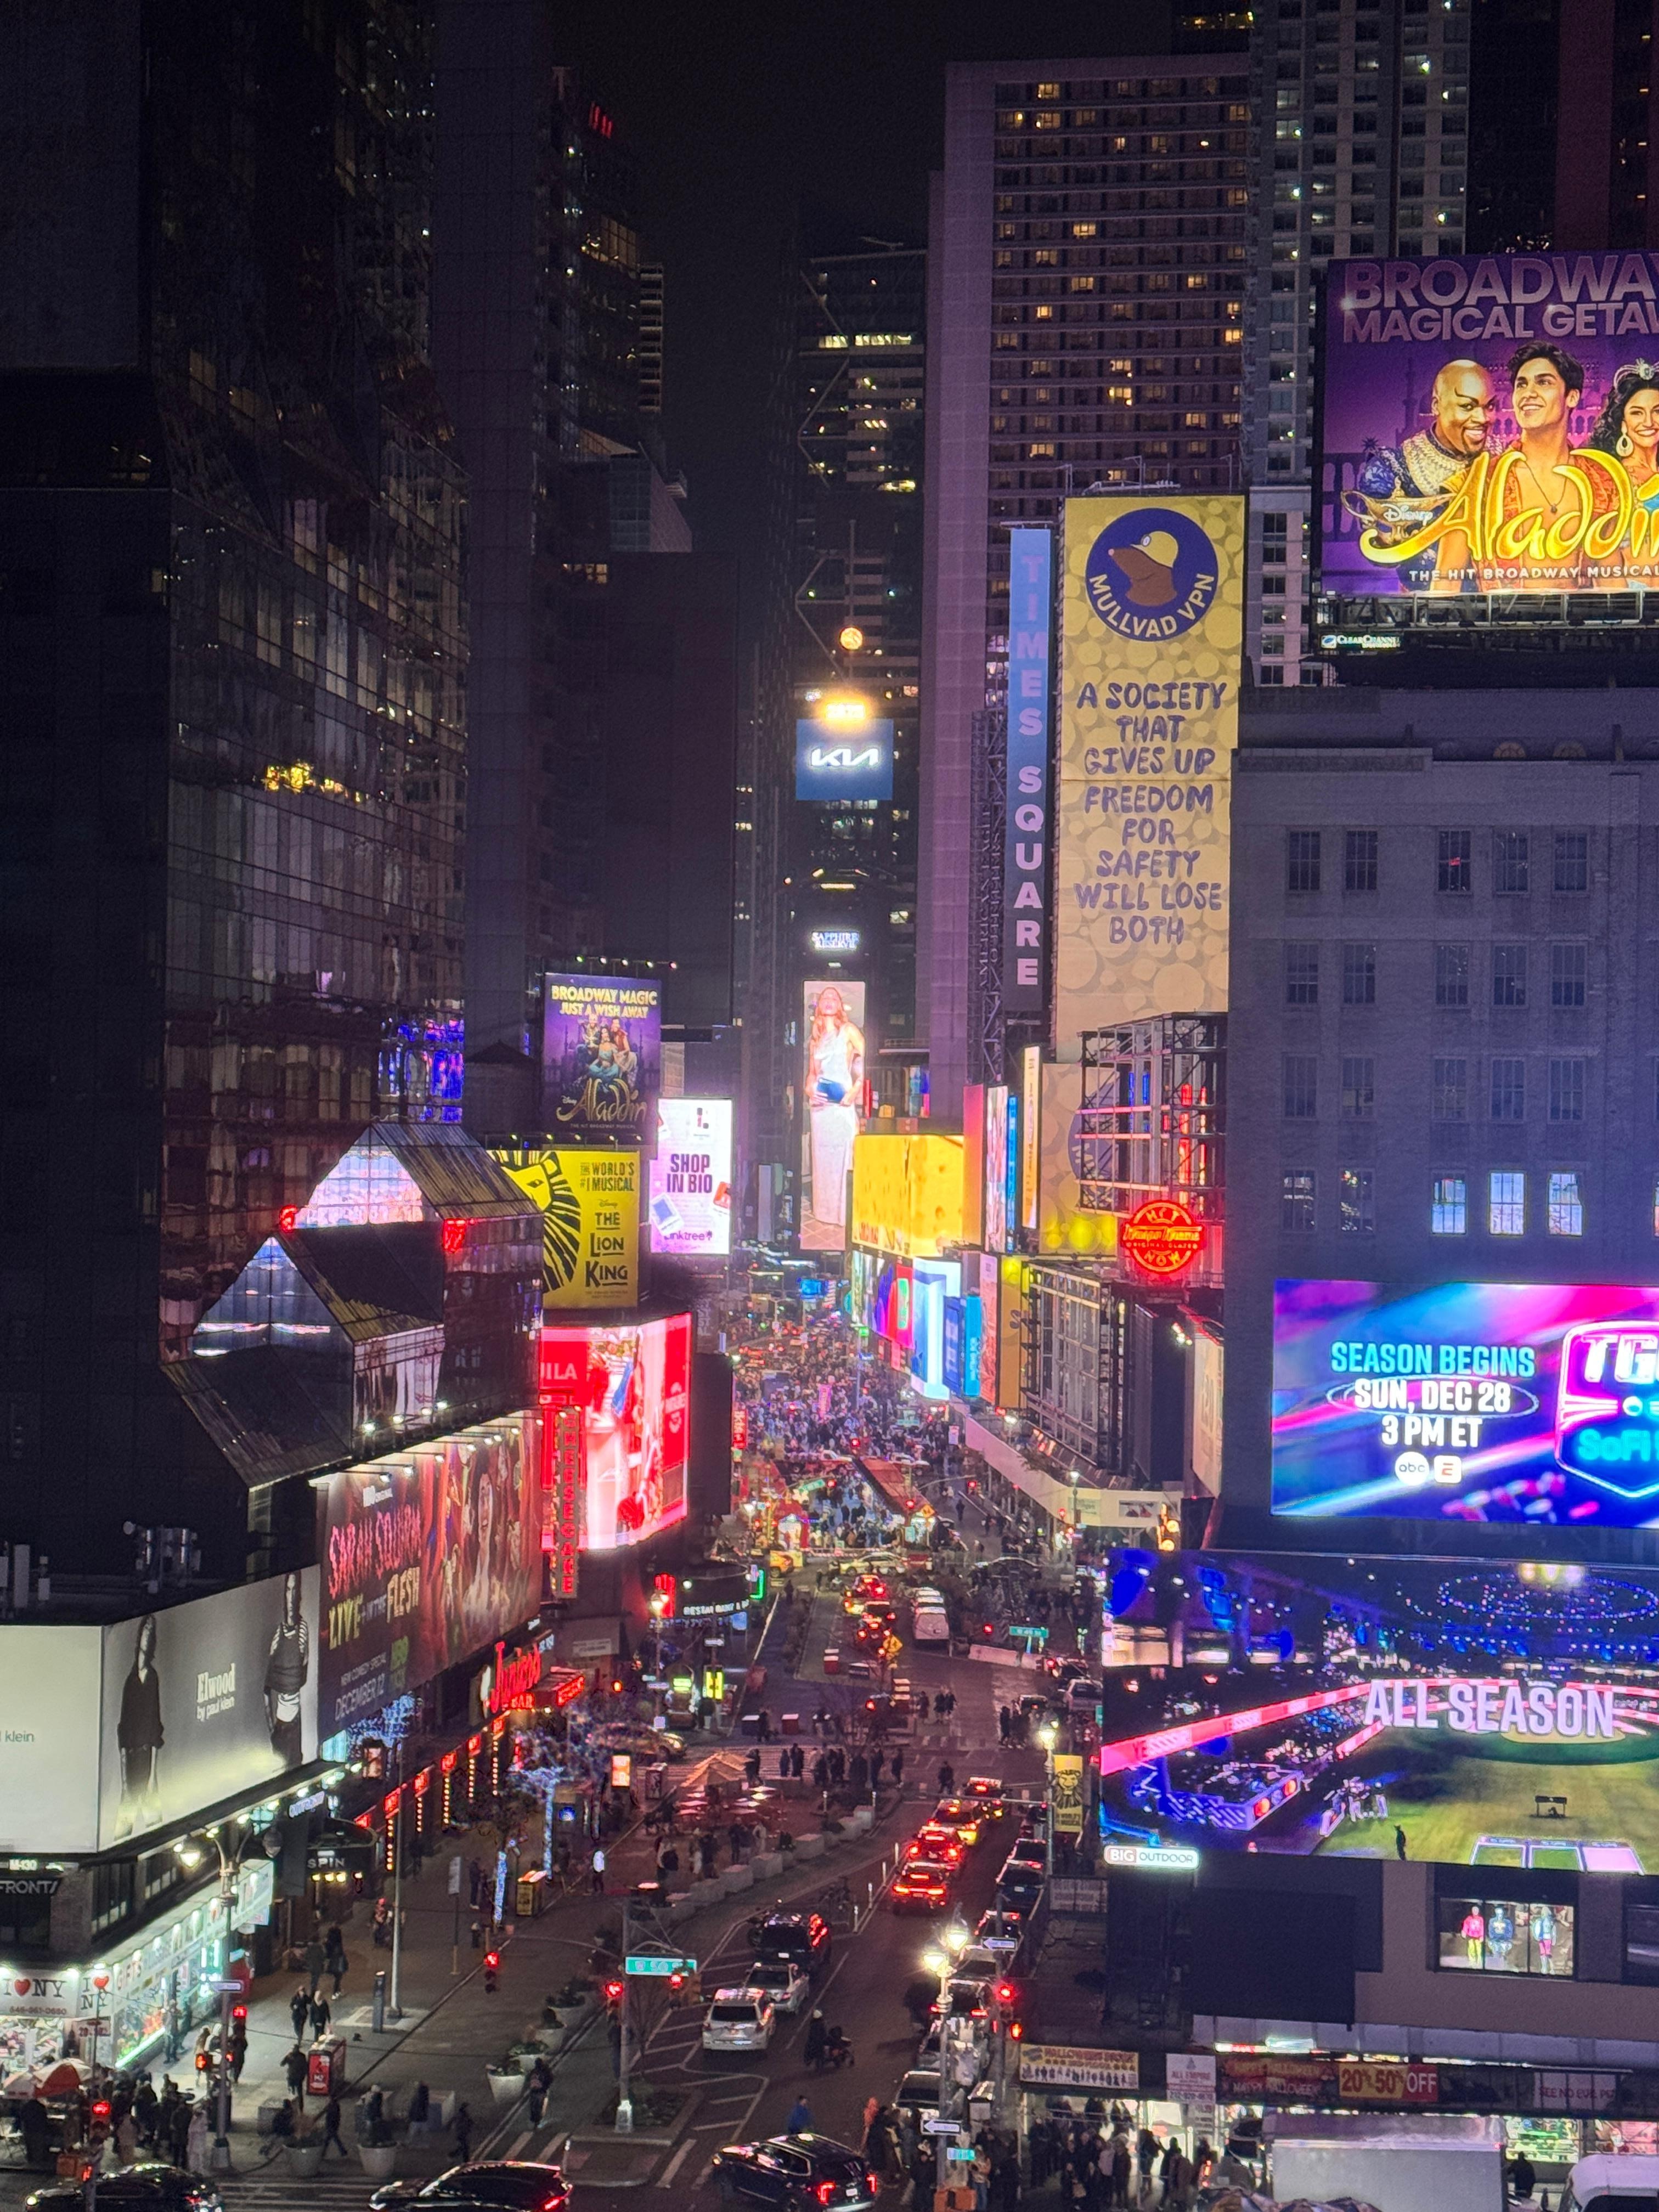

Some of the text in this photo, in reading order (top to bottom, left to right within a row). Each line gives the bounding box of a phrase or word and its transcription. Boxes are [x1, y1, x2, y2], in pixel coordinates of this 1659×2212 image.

[1342, 306, 1534, 343] MAGICAL
[1384, 505, 1433, 525] Disney
[1409, 570, 1440, 582] THE
[1448, 569, 1476, 580] HIT
[1483, 567, 1579, 580] BROADWAY
[1090, 573, 1215, 637] MULLVAD VPN
[1017, 556, 1048, 736] TIMES
[1076, 682, 1227, 710] A SOCIETY
[1116, 715, 1186, 743] THAT
[810, 748, 880, 767] KIA
[1084, 746, 1216, 775] GIVES UP
[1084, 783, 1214, 814] FREEDOM
[1121, 817, 1176, 846] FOR
[1013, 766, 1044, 985] SQUARE
[1096, 849, 1201, 878] SAFETY
[1073, 882, 1222, 911] WILL LOSE
[811, 932, 859, 941] SAPPHIRE
[1109, 915, 1184, 945] BOTH
[551, 985, 658, 1005] BROADWAY MAGIC
[559, 1002, 649, 1019] JUST A WISH AWAY
[556, 1078, 648, 1122] Aladdin
[561, 1095, 577, 1105] Disney
[592, 1161, 635, 1176] WORLD'S
[670, 1153, 710, 1173] SHOP
[592, 1177, 635, 1192] MUSICAL
[667, 1173, 713, 1193] IN BIO
[595, 1212, 620, 1226] THE
[590, 1233, 624, 1257] LION
[1144, 1250, 1183, 1267] NOW
[585, 1261, 628, 1288] KING
[1330, 1341, 1536, 1378] SEASON BEGINS
[1580, 1334, 1659, 1384] TG
[1354, 1378, 1511, 1414] SUN, DEC 28
[1381, 1417, 1483, 1448] 3 PM ET
[1398, 1463, 1425, 1474] abc
[561, 1414, 577, 1593] CHEESECAKE
[386, 1567, 421, 1624] FLESH
[196, 1663, 236, 1704] Elwood
[196, 1694, 235, 1722] by paul klein
[335, 1677, 376, 1721] DECEMBER
[1364, 1679, 1615, 1738] ALL SEASON
[5, 1730, 35, 1743] klein
[307, 1857, 346, 1869] SPIN
[1109, 1848, 1194, 1864] BIG OUTDOOR
[650, 1960, 668, 1972] 50
[3, 1978, 66, 1999] I NY
[82, 1977, 91, 1993] I
[1407, 2072, 1437, 2094] OFF
[1559, 2088, 1575, 2098] NO
